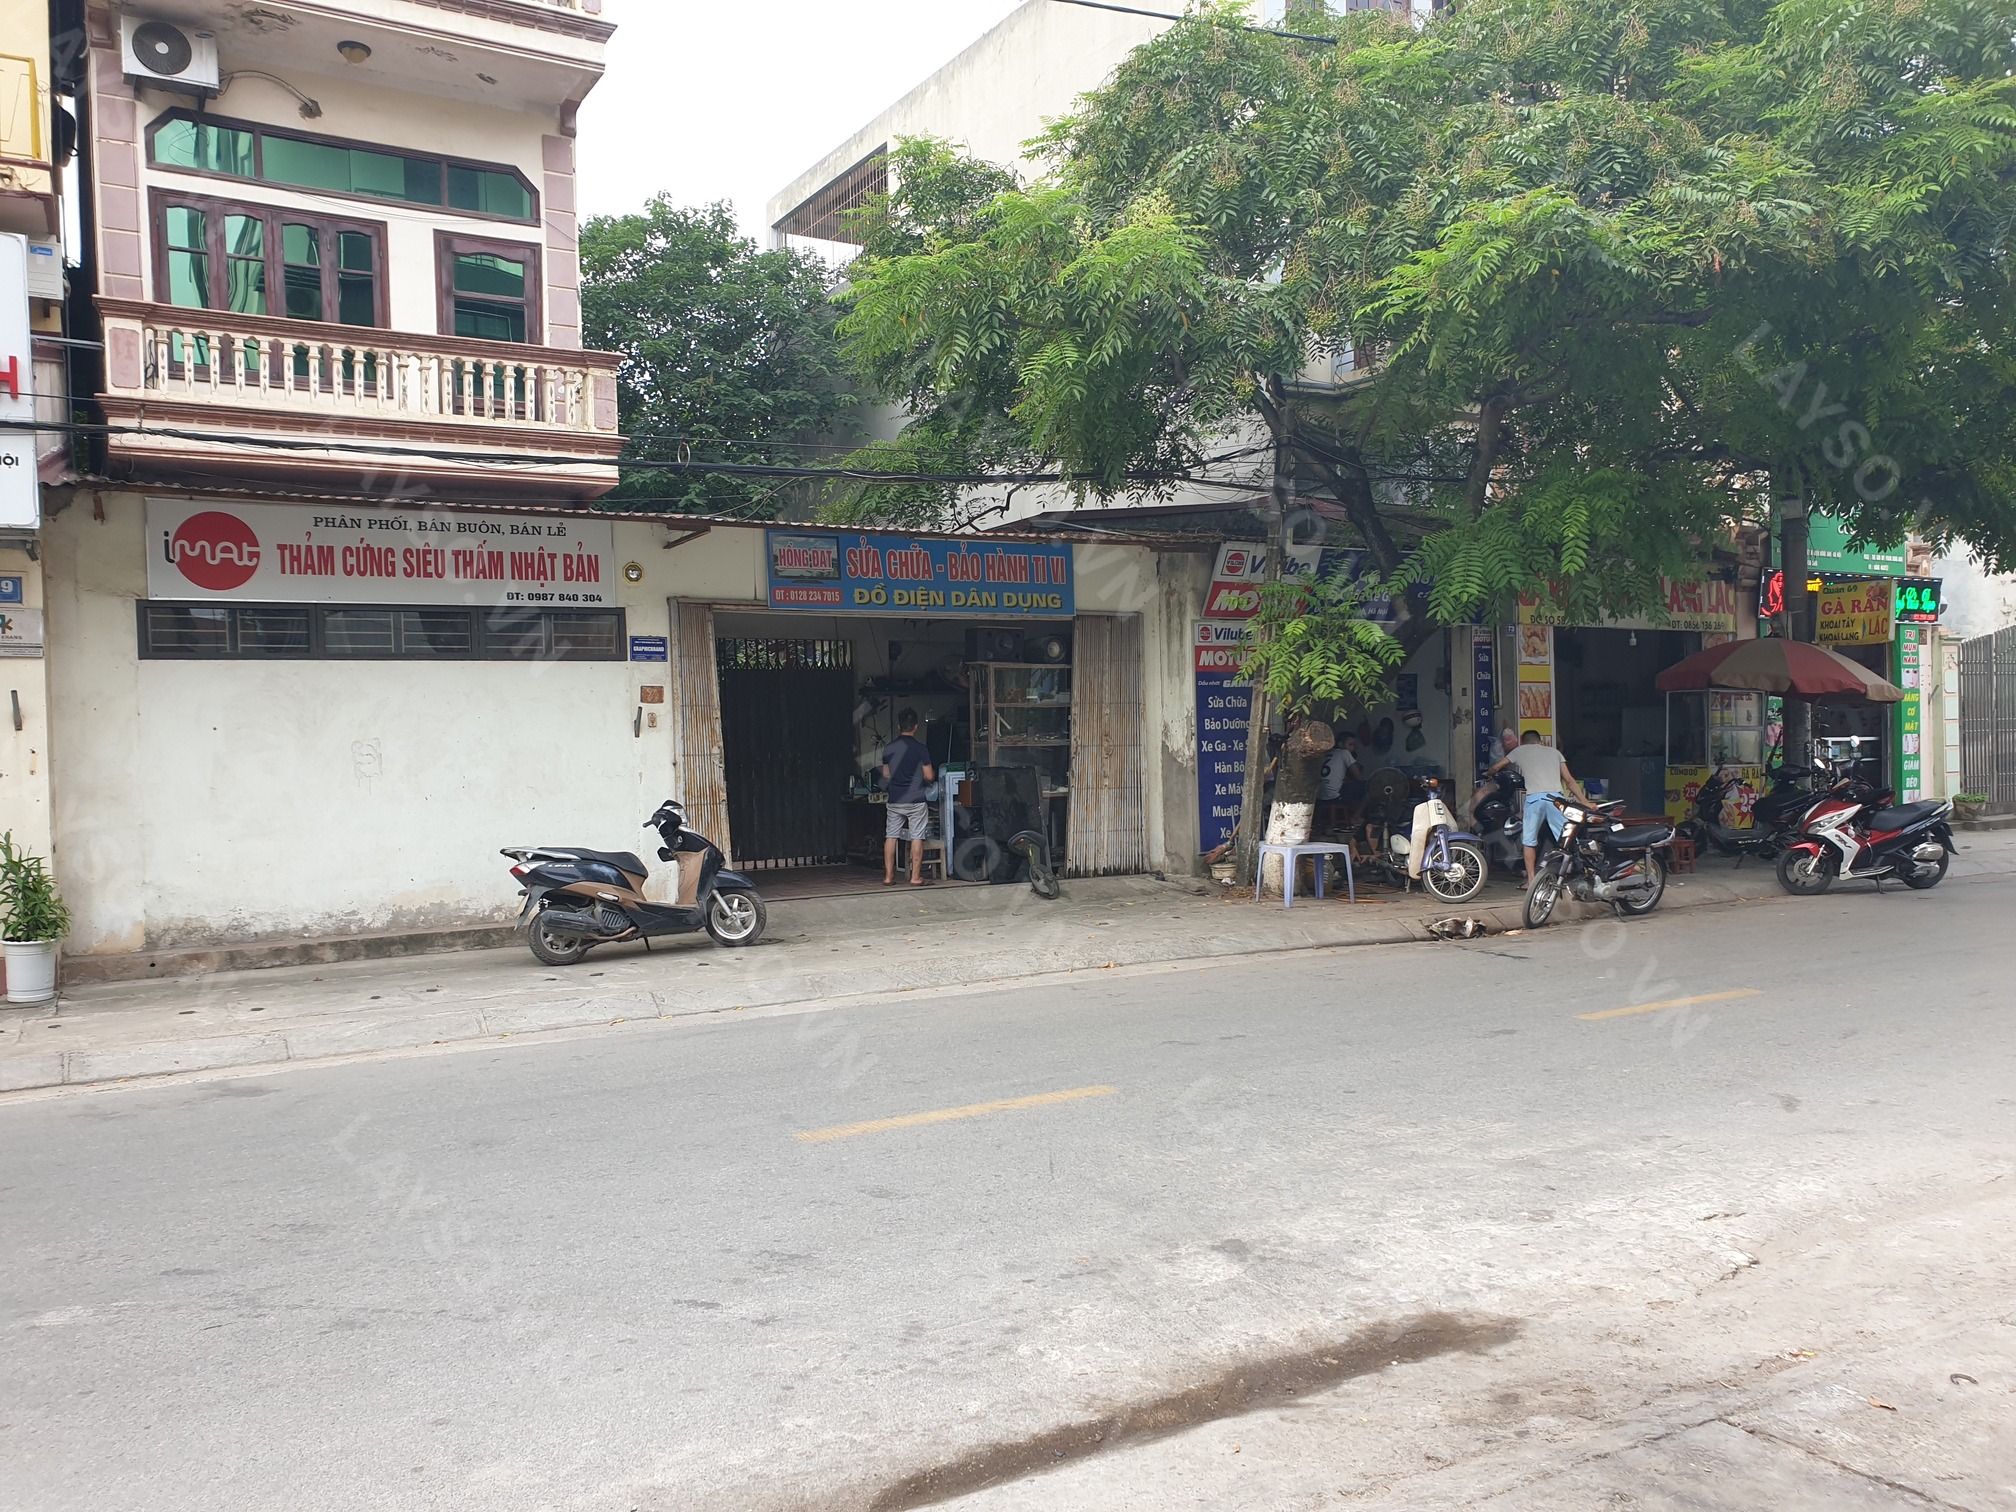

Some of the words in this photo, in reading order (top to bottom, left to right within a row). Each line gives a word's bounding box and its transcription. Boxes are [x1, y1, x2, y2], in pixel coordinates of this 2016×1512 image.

[313, 514, 361, 529] PHÂN
[367, 515, 413, 532] PHỐI,
[417, 518, 451, 532] BÁN
[456, 520, 505, 536] BUÔN,
[509, 522, 542, 536] BÁN
[547, 522, 567, 537] LẺ
[277, 531, 335, 576] THẢM
[342, 537, 396, 578] CỨNG
[402, 542, 446, 579] SIÊU
[451, 539, 505, 580] THẤM
[510, 546, 557, 588] NHẬT
[563, 541, 600, 583] BẢN
[778, 541, 809, 568] HỒNG
[810, 548, 834, 571] ĐẠT
[846, 536, 884, 579] SỬA
[887, 543, 934, 581] CHỮA
[947, 540, 982, 582] BẢO
[984, 548, 1029, 583] HÀNH
[1032, 555, 1047, 584] TI
[1050, 556, 1066, 585] VI
[527, 592, 554, 602] 0987
[558, 593, 579, 602] 840
[582, 593, 602, 602] 304
[790, 590, 808, 601] 0128
[823, 591, 840, 602] 7015
[853, 582, 888, 606] ĐỒ
[893, 586, 946, 611] ĐIỆN
[951, 587, 998, 608] DÂN
[1003, 592, 1064, 612] DỤNG
[1821, 597, 1846, 615] GÀ
[1820, 619, 1841, 630] KHOAI
[1819, 632, 1840, 642] KHOAI
[1840, 631, 1859, 641] LANG
[1480, 689, 1488, 698] Xe
[1208, 695, 1224, 708] Sửa
[1225, 695, 1247, 708] Chữa
[1480, 707, 1489, 716] Ga
[1204, 717, 1221, 730] Bảo
[1222, 717, 1250, 732] Dưỡng
[1480, 725, 1489, 734] Xe
[1201, 740, 1213, 752] Xe
[1214, 740, 1227, 752] Ga
[1232, 739, 1244, 751] Xe
[1214, 761, 1232, 774] Hàn
[1214, 783, 1226, 795] Xe
[1212, 805, 1232, 817] Mua
[1220, 827, 1231, 839] Xe
